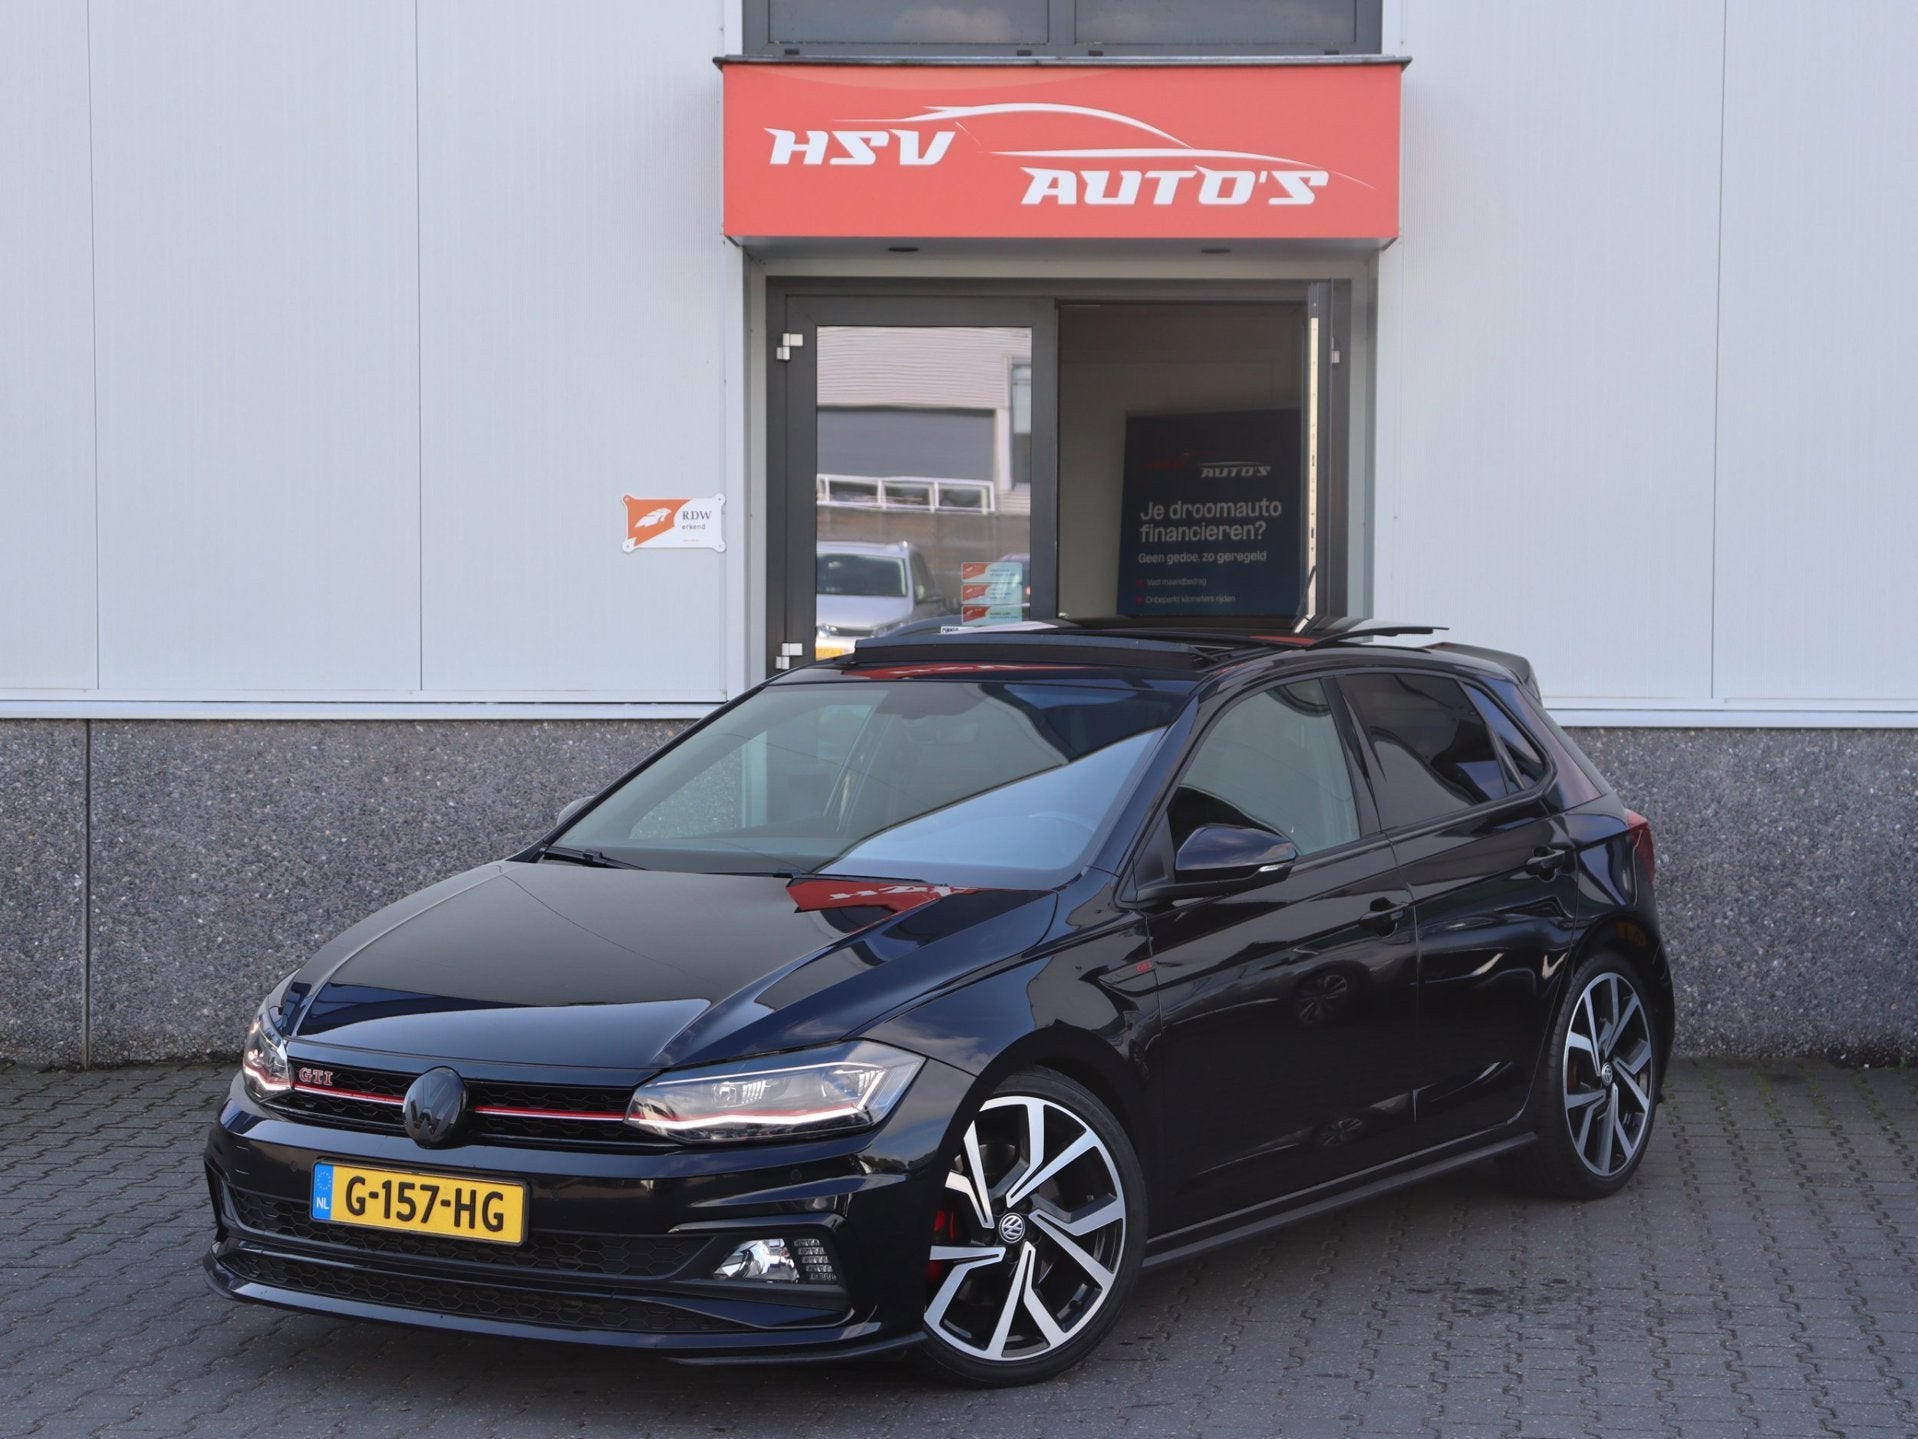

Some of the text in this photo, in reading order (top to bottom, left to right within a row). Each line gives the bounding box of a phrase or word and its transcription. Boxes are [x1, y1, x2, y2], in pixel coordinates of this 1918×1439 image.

[763, 127, 956, 166] HSV
[1019, 165, 1330, 206] AUTO'S
[682, 511, 711, 520] RDW
[1140, 499, 1282, 520] Je droomauto
[1140, 521, 1266, 542] financieren?
[1138, 552, 1165, 564] Geen
[1202, 553, 1215, 562] zo
[1217, 550, 1267, 563] geregeld
[299, 1067, 334, 1087] GTI
[316, 1176, 504, 1232] NL G-157-HG
